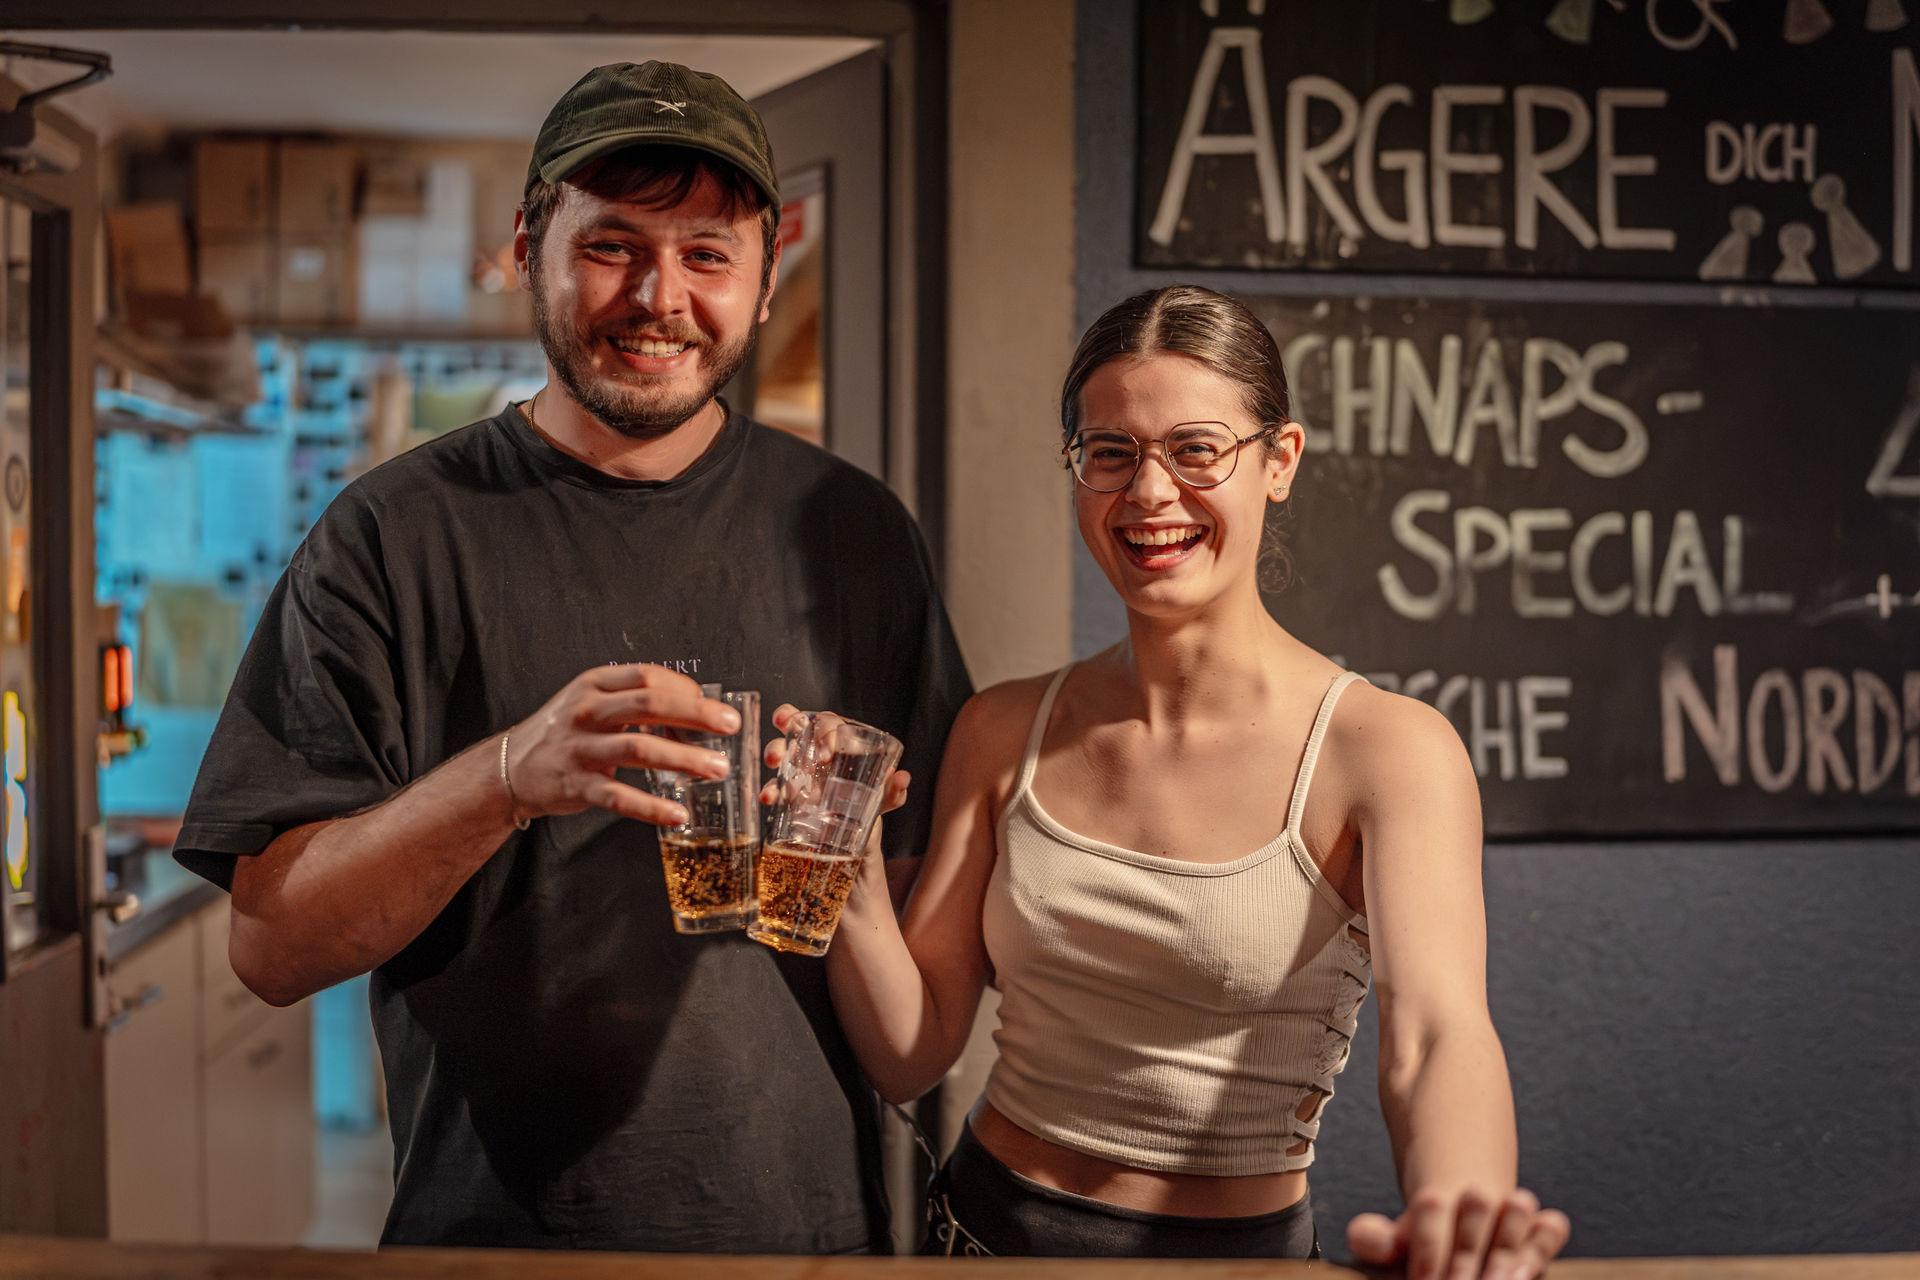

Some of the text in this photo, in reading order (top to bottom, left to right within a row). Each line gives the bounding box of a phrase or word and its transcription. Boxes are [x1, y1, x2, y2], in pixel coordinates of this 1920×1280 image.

[1148, 0, 1677, 251] ÄRGERE
[1704, 119, 1817, 185] DICH
[1285, 333, 1703, 477] CHNAPS-
[1377, 489, 1794, 620] SPECIAL
